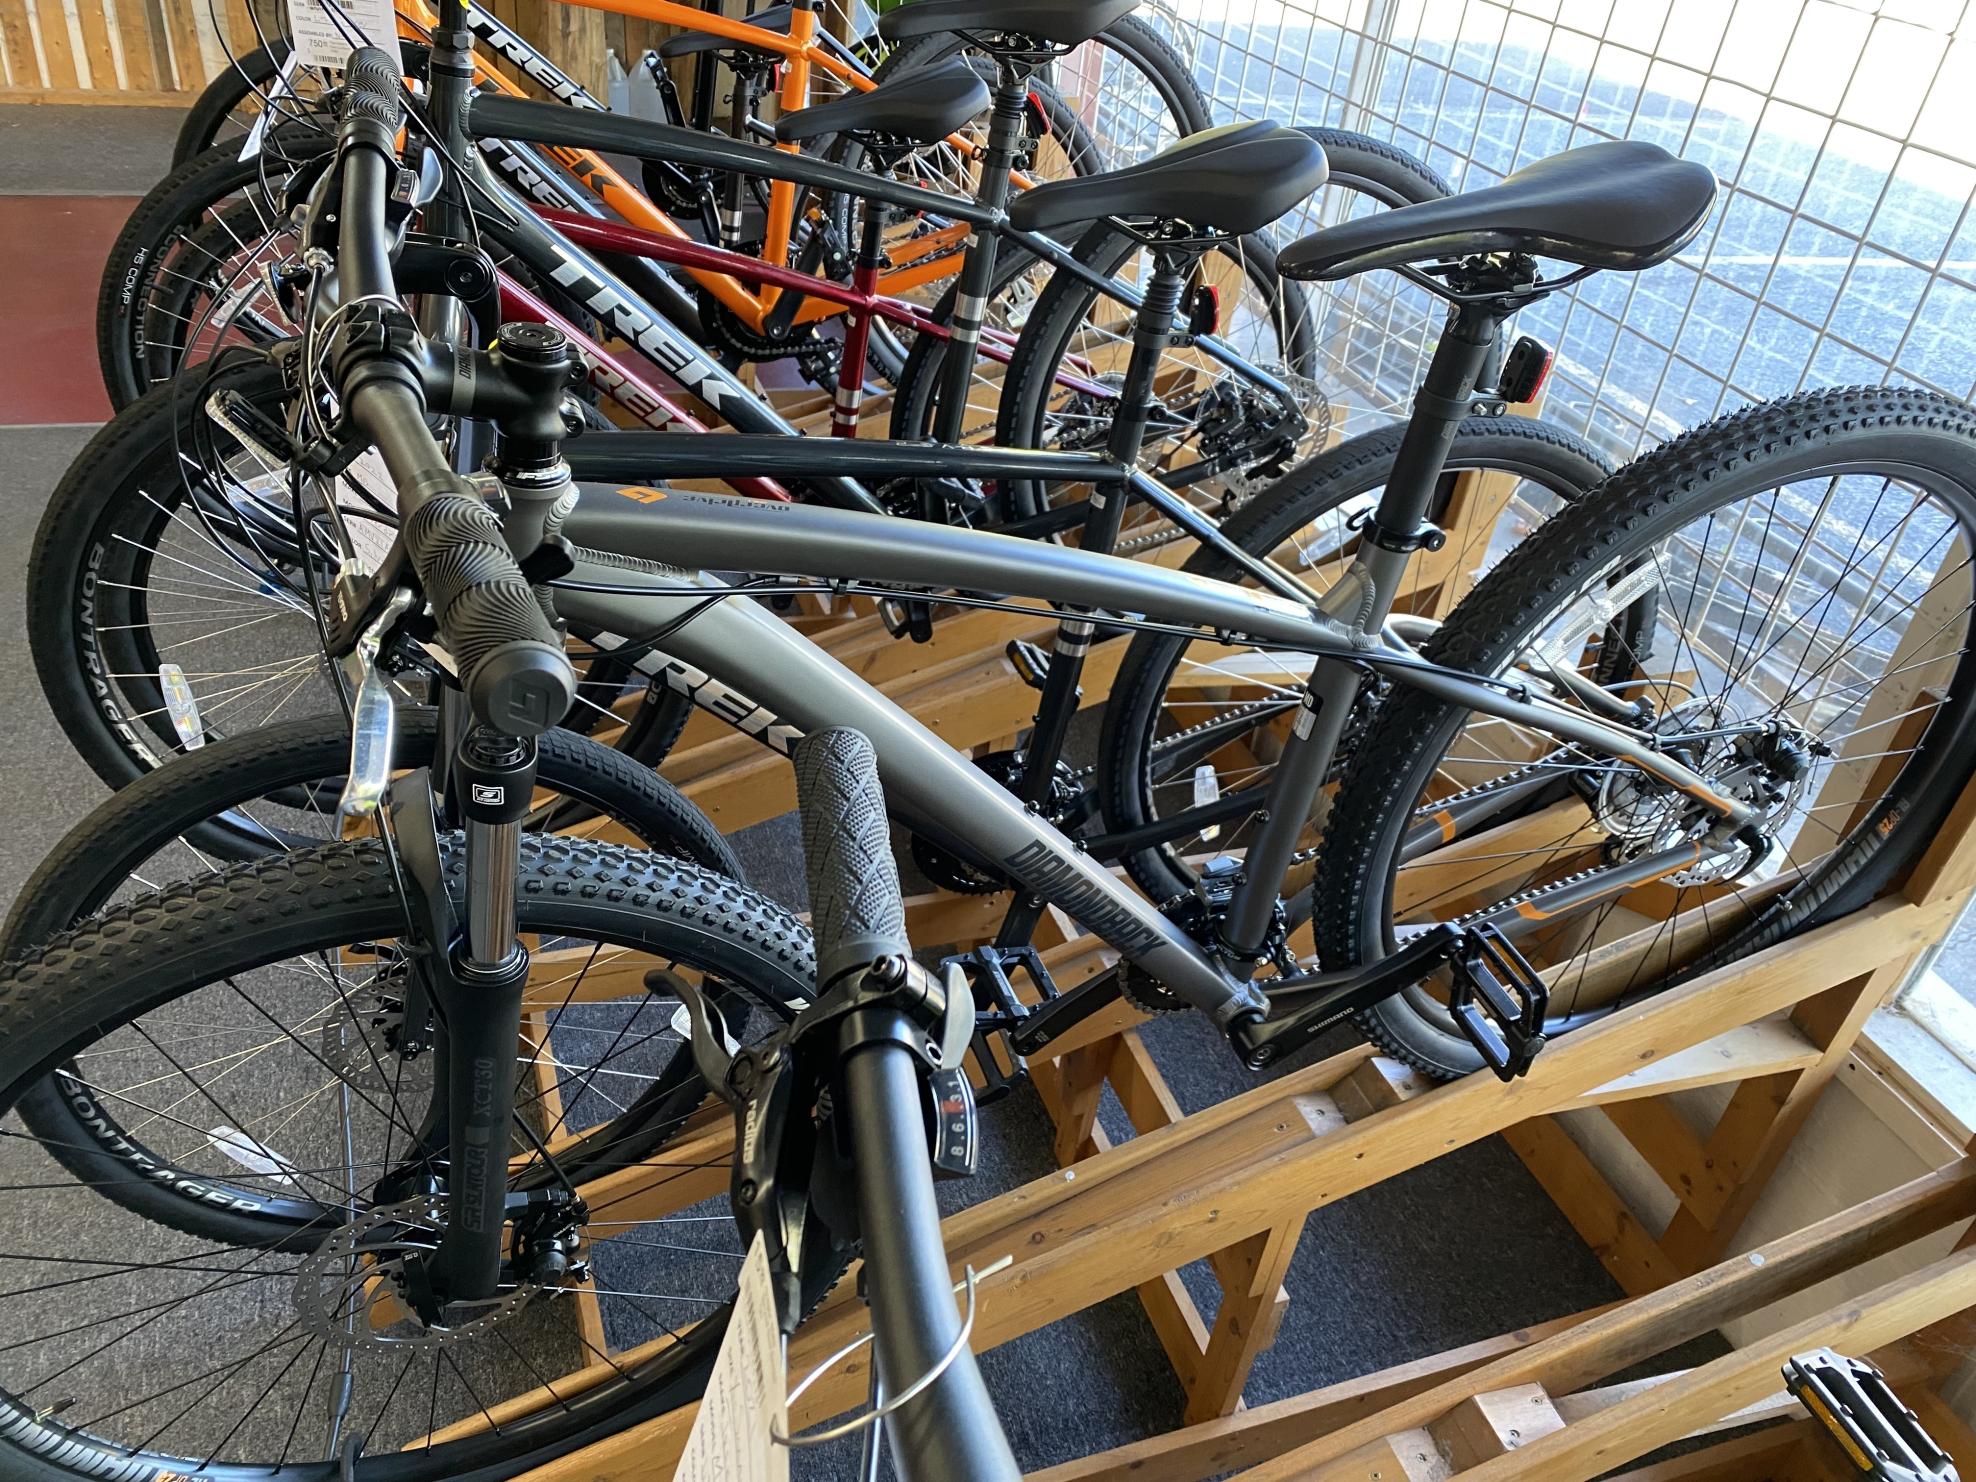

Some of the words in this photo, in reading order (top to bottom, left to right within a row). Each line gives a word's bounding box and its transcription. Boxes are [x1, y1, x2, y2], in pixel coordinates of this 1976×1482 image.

[478, 136, 580, 214] TRE
[121, 267, 138, 305] COMP
[134, 234, 177, 359] CONNECTION
[550, 244, 741, 411] TREK
[80, 541, 164, 769] BONTRAGER
[1003, 839, 1169, 957] DIAMONDBACK
[1307, 1007, 1354, 1032] SHIMANO
[61, 1076, 262, 1213] BONTRAGER
